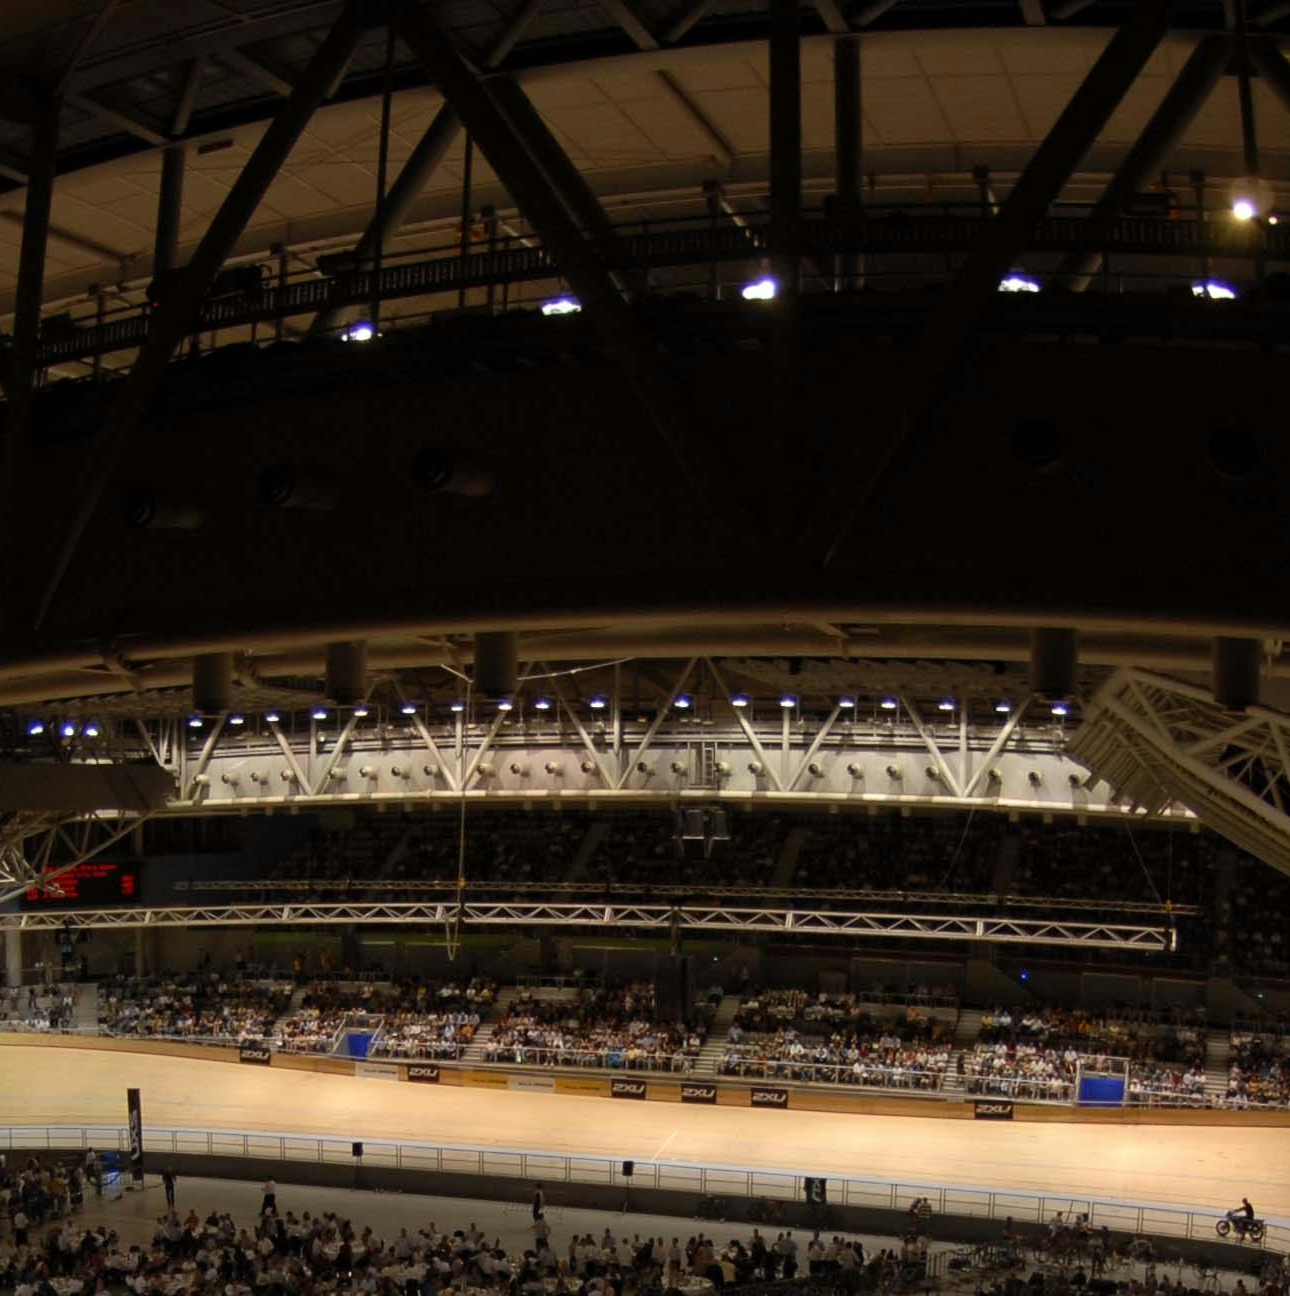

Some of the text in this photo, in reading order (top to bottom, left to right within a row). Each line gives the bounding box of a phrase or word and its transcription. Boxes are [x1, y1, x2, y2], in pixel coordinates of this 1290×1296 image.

[612, 1083, 645, 1093] 2XU
[682, 1087, 715, 1098] 2XU
[752, 1092, 787, 1103] 2XU
[975, 1103, 1012, 1114] 2XU
